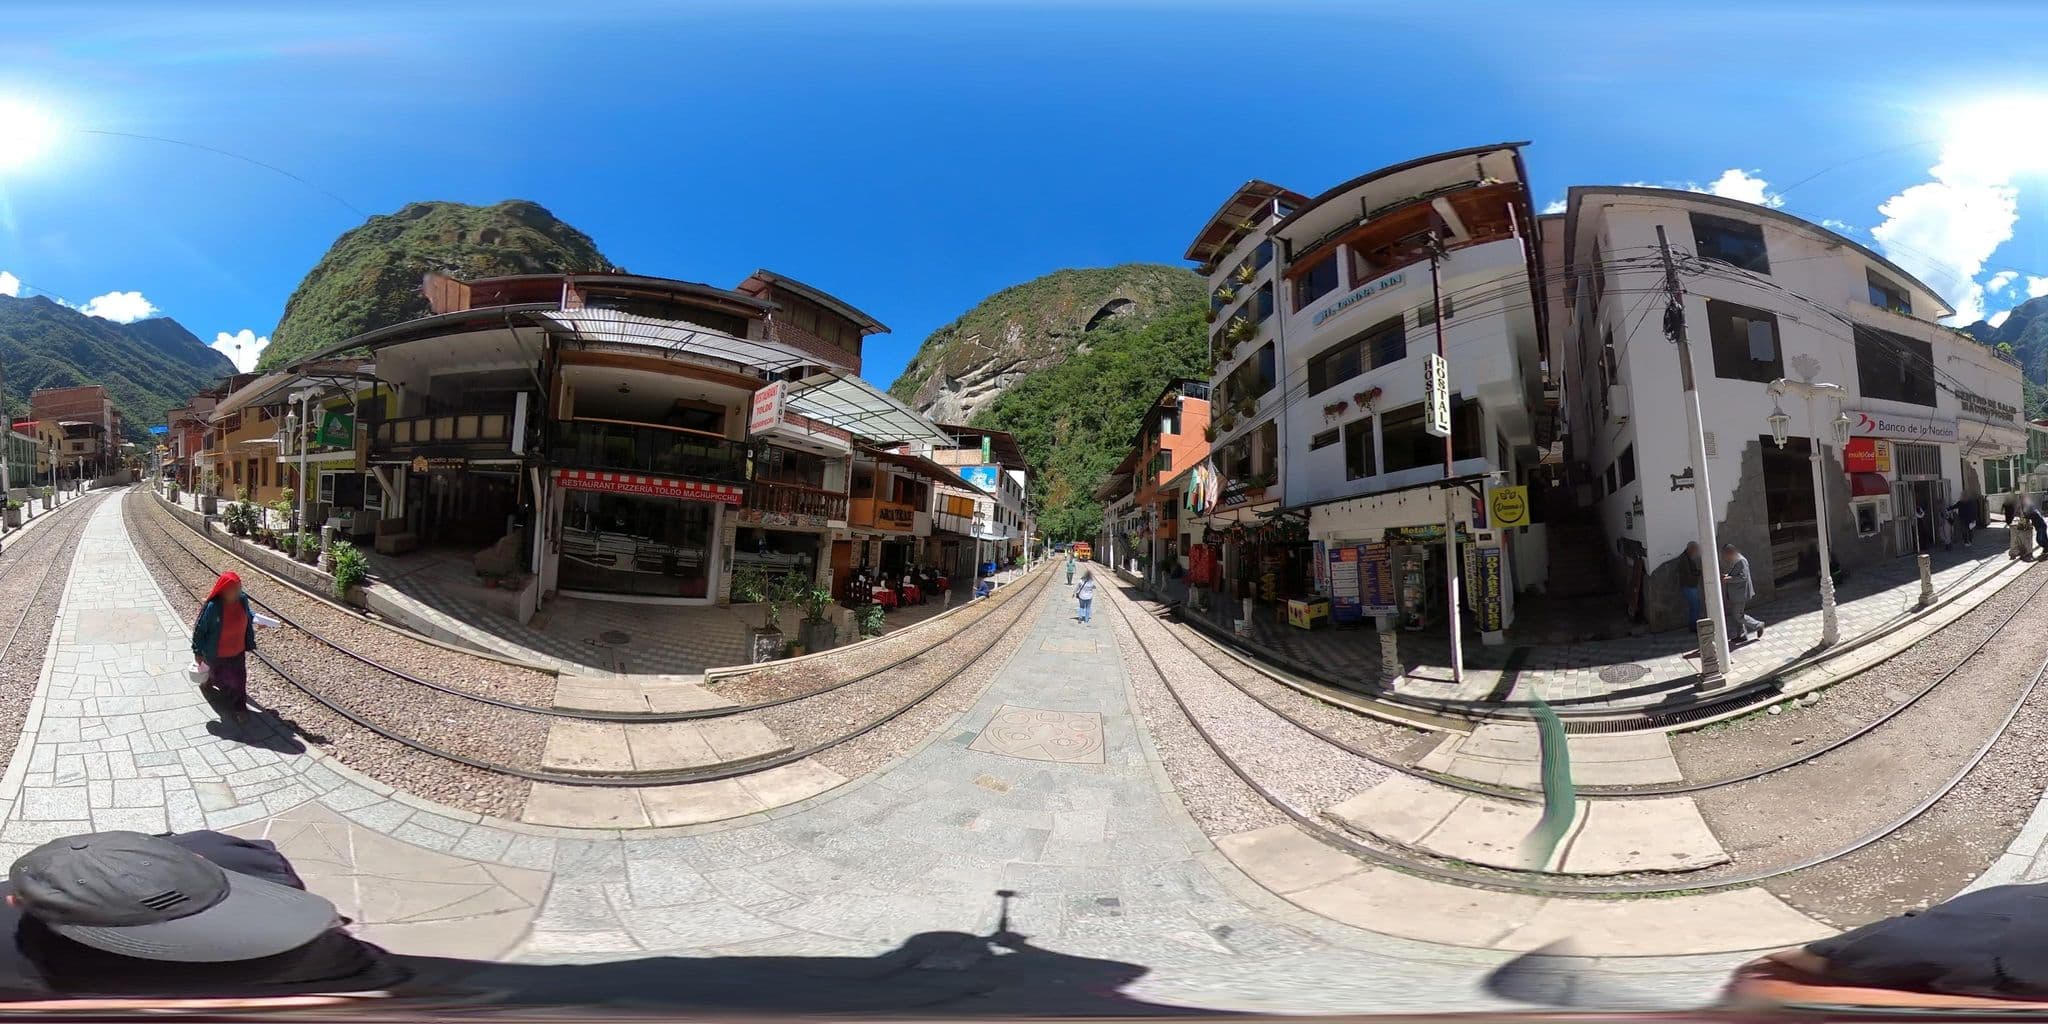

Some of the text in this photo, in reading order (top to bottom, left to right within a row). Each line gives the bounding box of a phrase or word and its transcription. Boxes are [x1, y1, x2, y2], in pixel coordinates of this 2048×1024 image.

[1424, 360, 1434, 424] HOSTAL
[1436, 357, 1448, 424] HOSTAL
[756, 402, 773, 416] TOLDO
[1988, 399, 1996, 409] DE
[1879, 420, 1905, 433] Banco
[1908, 425, 1917, 433] de
[1920, 425, 1927, 434] la
[561, 479, 615, 490] RESTAURANT
[655, 486, 681, 496] TOLDO
[683, 490, 738, 502] MACHUPICCHU
